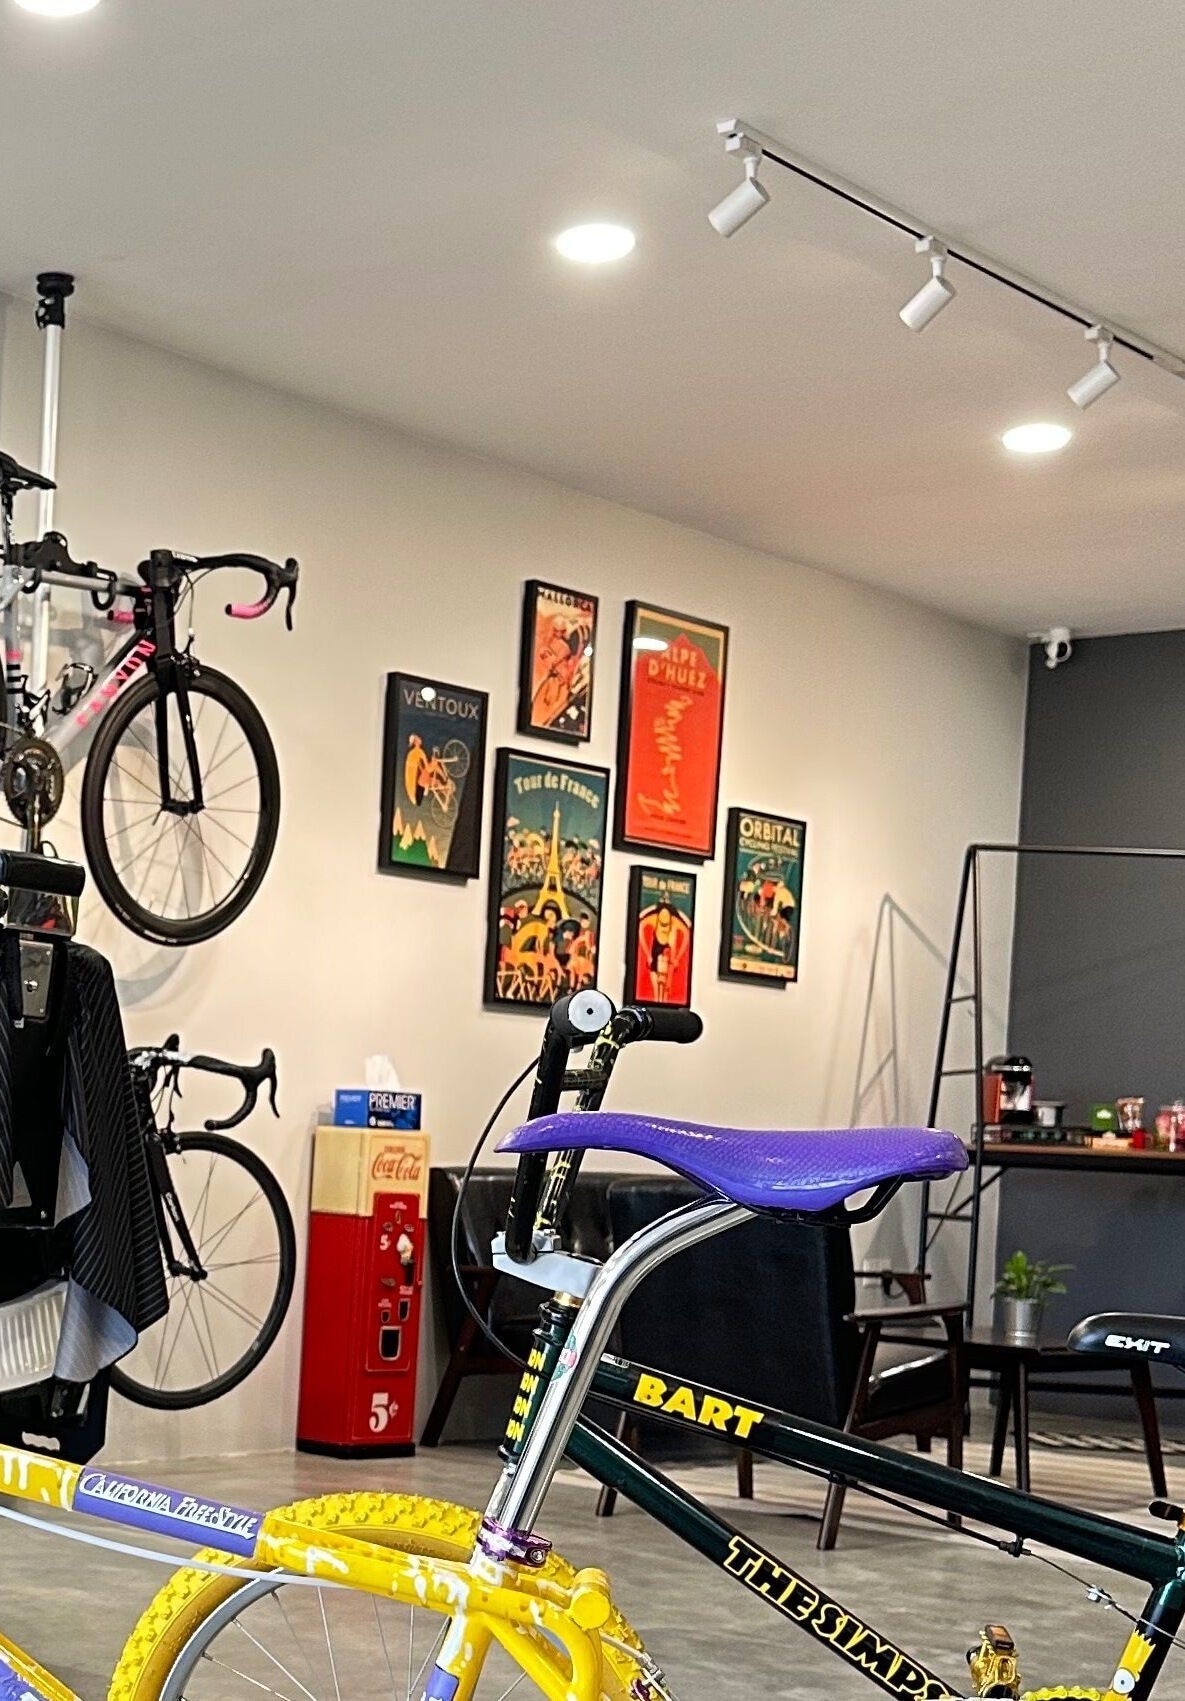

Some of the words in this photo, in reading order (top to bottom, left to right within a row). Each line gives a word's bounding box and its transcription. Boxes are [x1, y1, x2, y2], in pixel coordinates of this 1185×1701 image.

[75, 640, 157, 729] CANYON
[647, 659, 707, 689] D'HUEZ
[514, 775, 542, 794] Tour
[544, 771, 559, 789] de
[560, 773, 600, 809] France
[740, 817, 801, 848] ORBITAL
[369, 1093, 415, 1111] PREMIER
[1105, 1334, 1170, 1354] EXIT
[369, 1392, 399, 1433] 5¢
[633, 1373, 764, 1439] BART
[78, 1472, 172, 1514] CALIFORNIA
